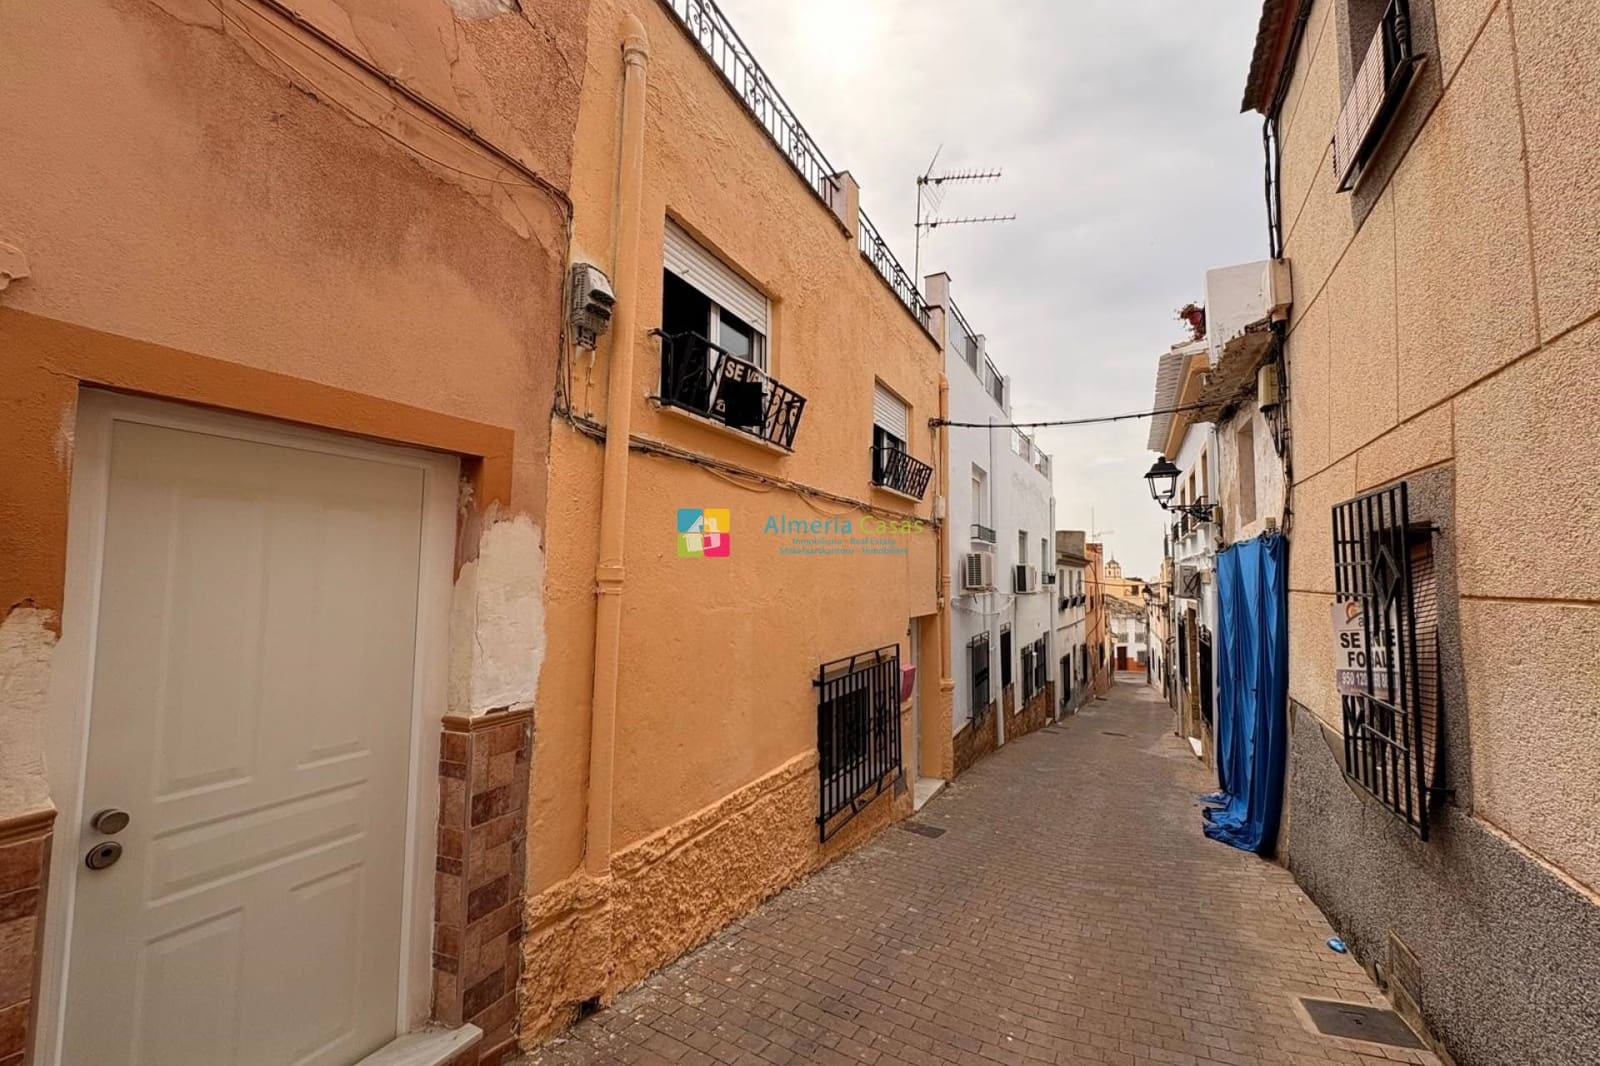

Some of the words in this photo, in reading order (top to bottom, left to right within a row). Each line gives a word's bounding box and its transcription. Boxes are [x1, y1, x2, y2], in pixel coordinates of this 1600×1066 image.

[724, 361, 744, 382] SE
[1340, 632, 1361, 648] SE
[1347, 651, 1370, 668] FO
